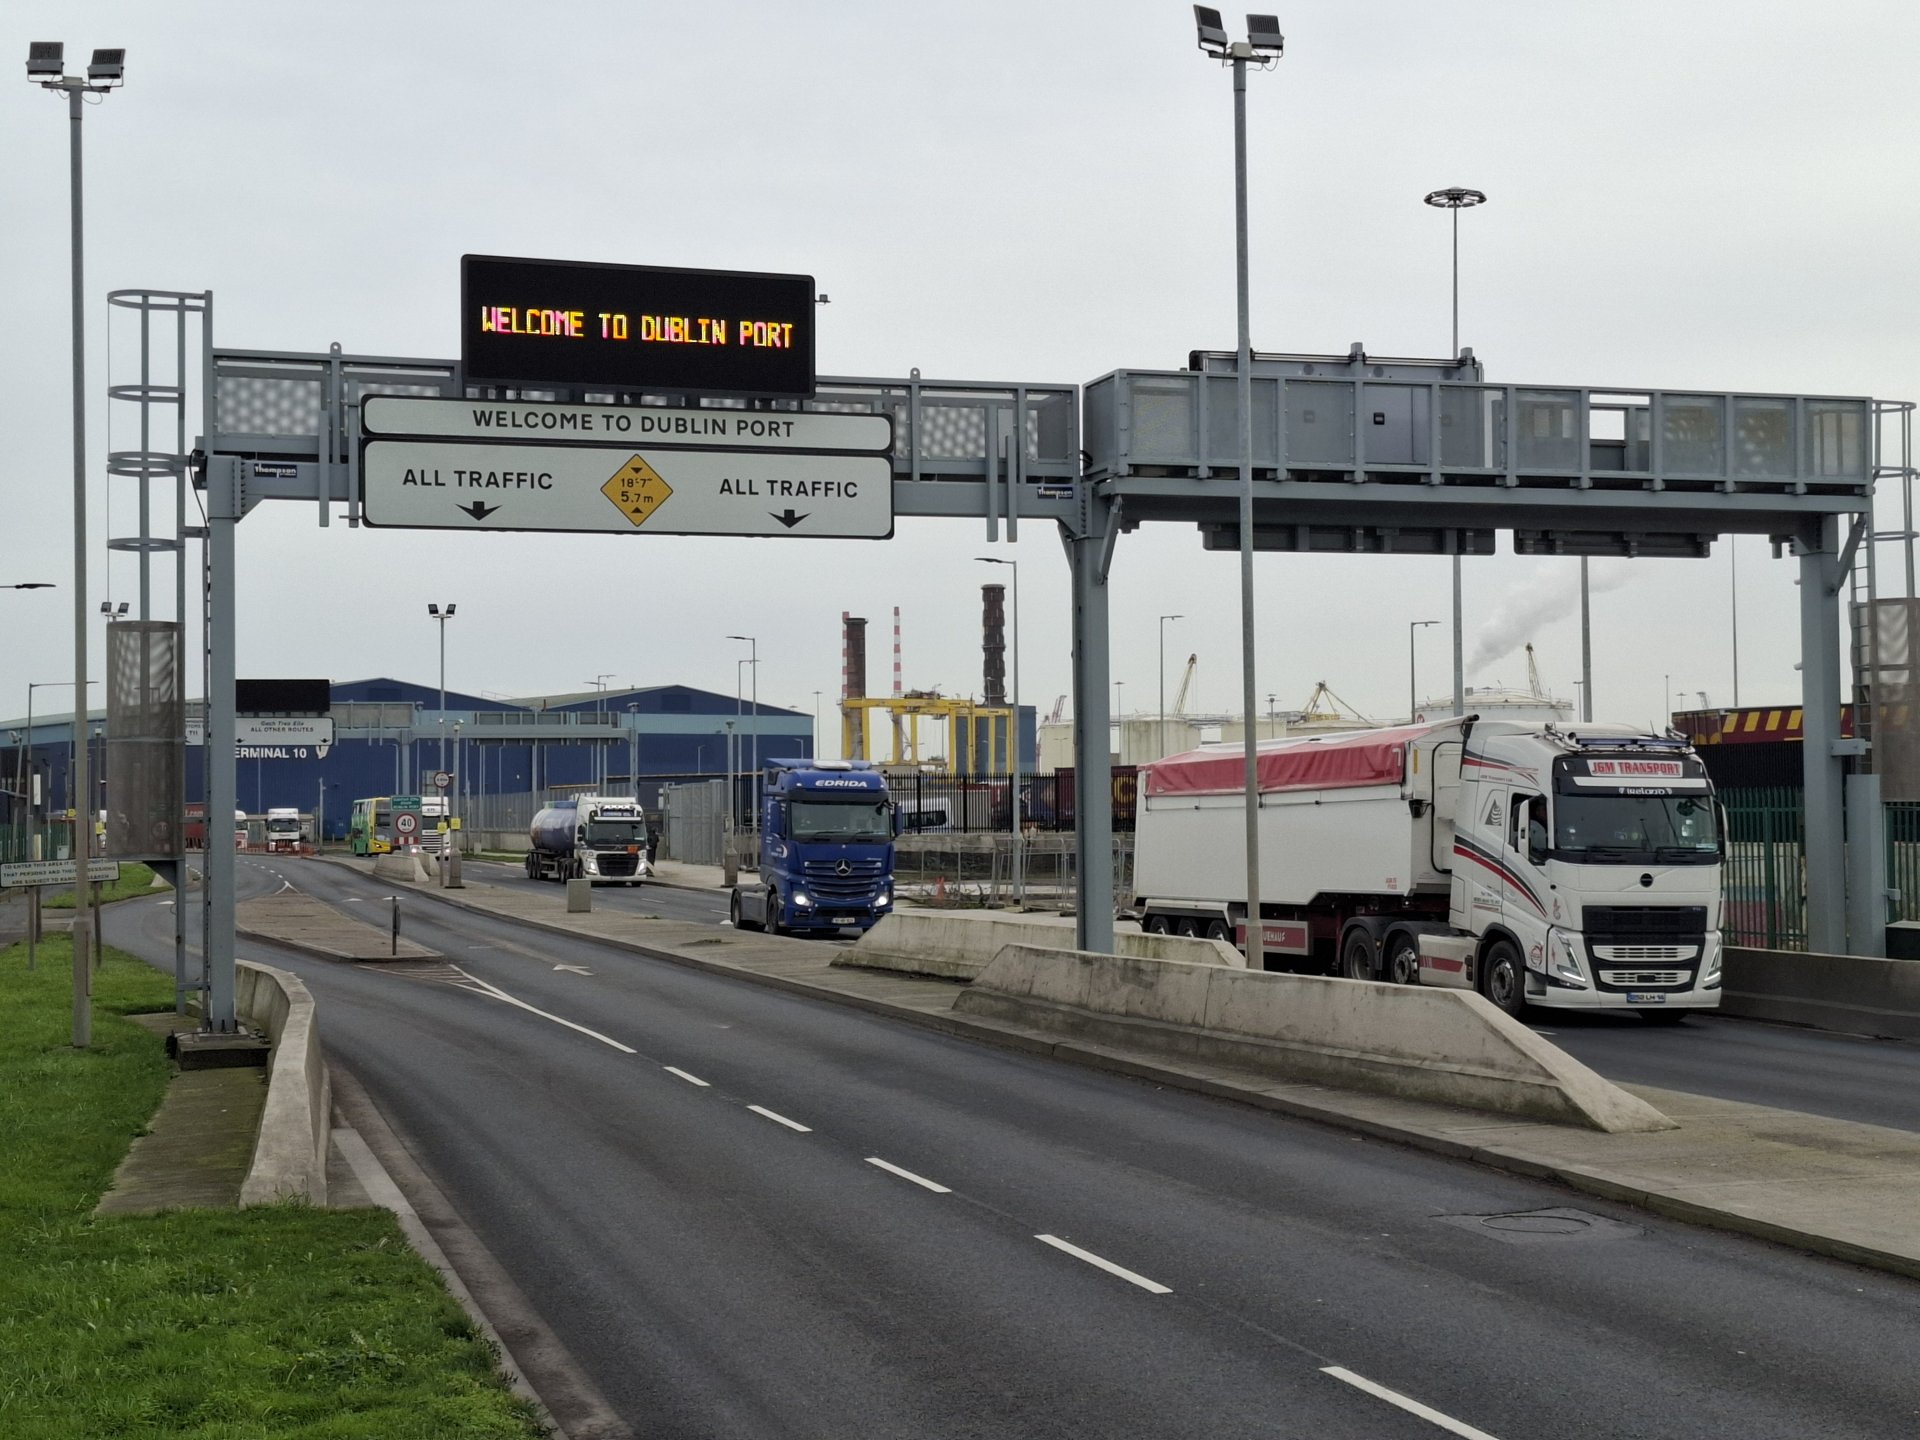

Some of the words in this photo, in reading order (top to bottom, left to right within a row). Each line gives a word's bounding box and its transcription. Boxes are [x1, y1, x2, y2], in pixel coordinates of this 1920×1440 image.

[482, 306, 584, 337] WELCOME
[599, 313, 627, 340] TO
[642, 315, 725, 345] DUBLIN
[739, 321, 793, 348] PORT
[473, 409, 593, 431] WELCOME
[603, 414, 631, 432] TO
[641, 415, 727, 435] DUBLIN
[737, 419, 794, 438] PORT
[403, 468, 446, 487] ALL
[454, 470, 553, 490] TRAFFIC
[720, 478, 759, 496] ALL
[767, 480, 858, 498] TRAFFIC
[234, 748, 289, 758] ERMINAL
[293, 748, 307, 758] 10
[1592, 761, 1616, 774] JGM
[1618, 762, 1680, 776] TRANSPORT
[815, 779, 868, 788] EDRIDA
[401, 818, 412, 827] 40
